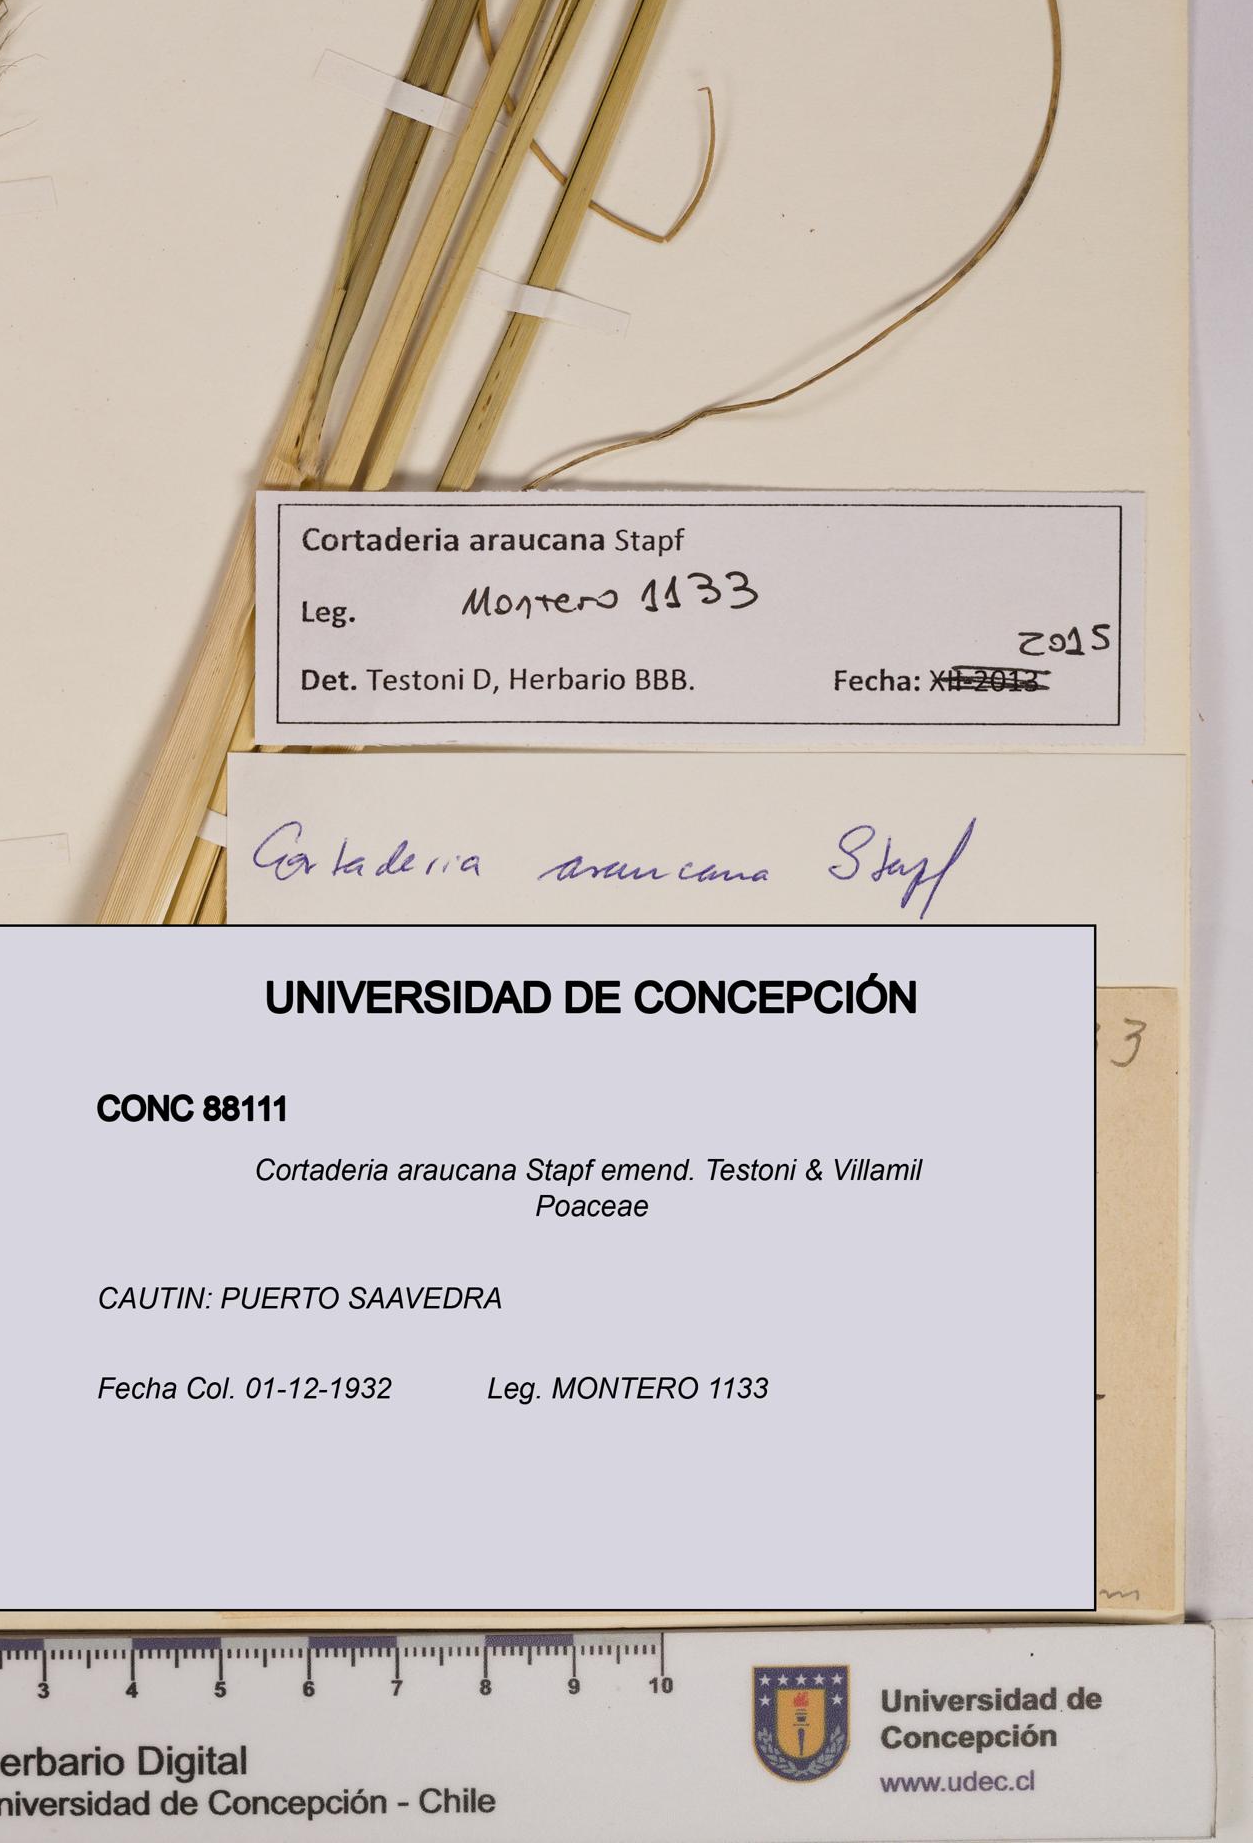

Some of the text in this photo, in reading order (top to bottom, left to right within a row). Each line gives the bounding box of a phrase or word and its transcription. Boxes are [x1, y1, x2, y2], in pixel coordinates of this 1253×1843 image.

[303, 527, 685, 556] Cortaderia araucana Stapf
[462, 571, 758, 619] Montero 1133
[303, 601, 355, 628] Leg.
[1018, 624, 1110, 656] 2015
[302, 667, 694, 694] Det. Testoni D, Herbario BBB.
[835, 669, 919, 691] Fecha:
[253, 821, 479, 880] Cortaderia
[38, 1684, 49, 1700] 3
[126, 1683, 138, 1699] 4
[214, 1682, 226, 1699] 5
[302, 1680, 314, 1698] 6
[392, 1680, 402, 1696] 7
[480, 1679, 492, 1696] 8
[568, 1678, 580, 1695] 9
[650, 1677, 674, 1694] 10
[882, 1687, 1102, 1712] Universidad de
[881, 1724, 1056, 1753] Concepción
[139, 1746, 246, 1783] Digital
[880, 1770, 1034, 1792] www.udec.cl
[161, 1790, 198, 1815] de
[208, 1789, 386, 1821] Concepción
[420, 1788, 495, 1813] Chile
